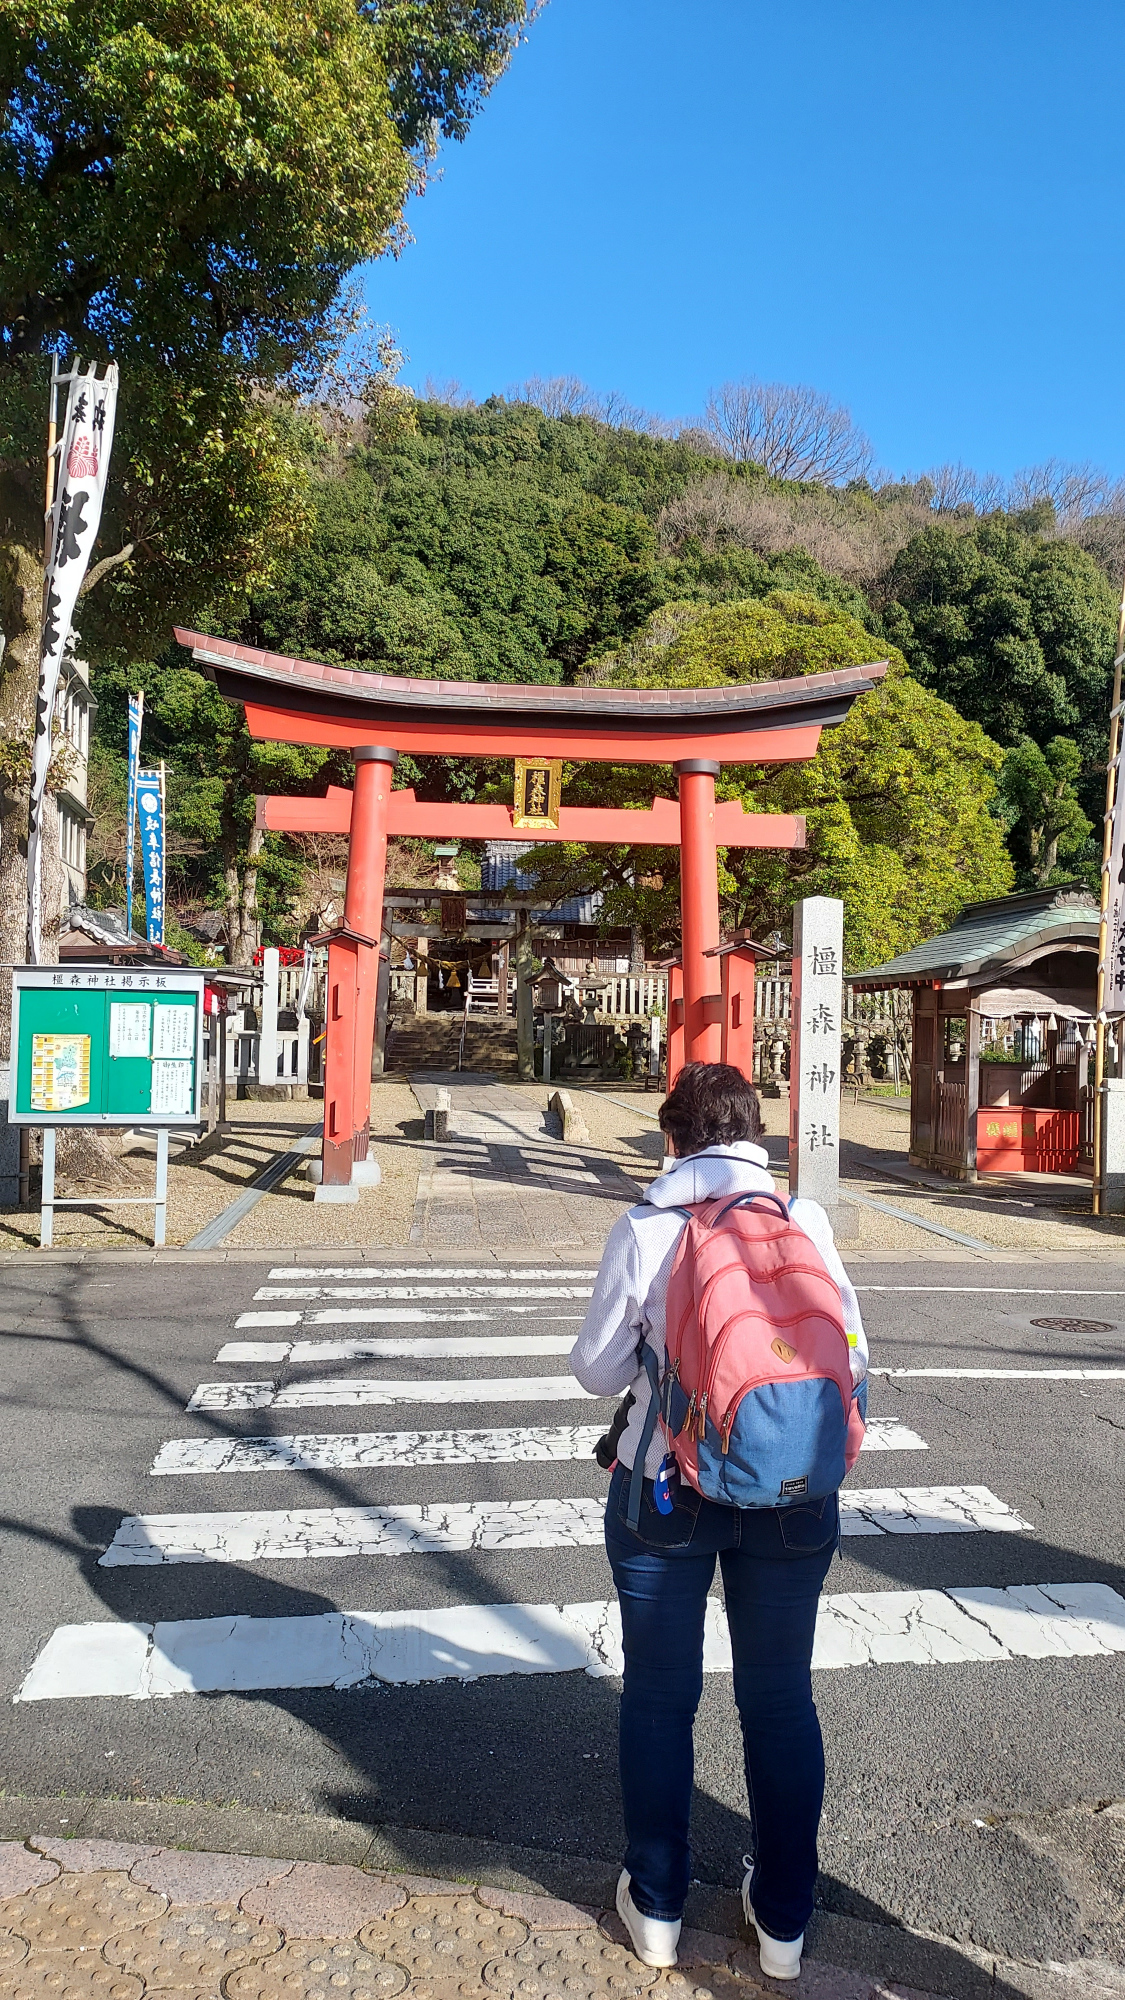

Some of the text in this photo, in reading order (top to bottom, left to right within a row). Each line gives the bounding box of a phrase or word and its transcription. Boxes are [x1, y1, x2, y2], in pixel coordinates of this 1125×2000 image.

[52, 973, 168, 988] 橿森神社掲示板
[805, 945, 838, 1152] 橿森神社
